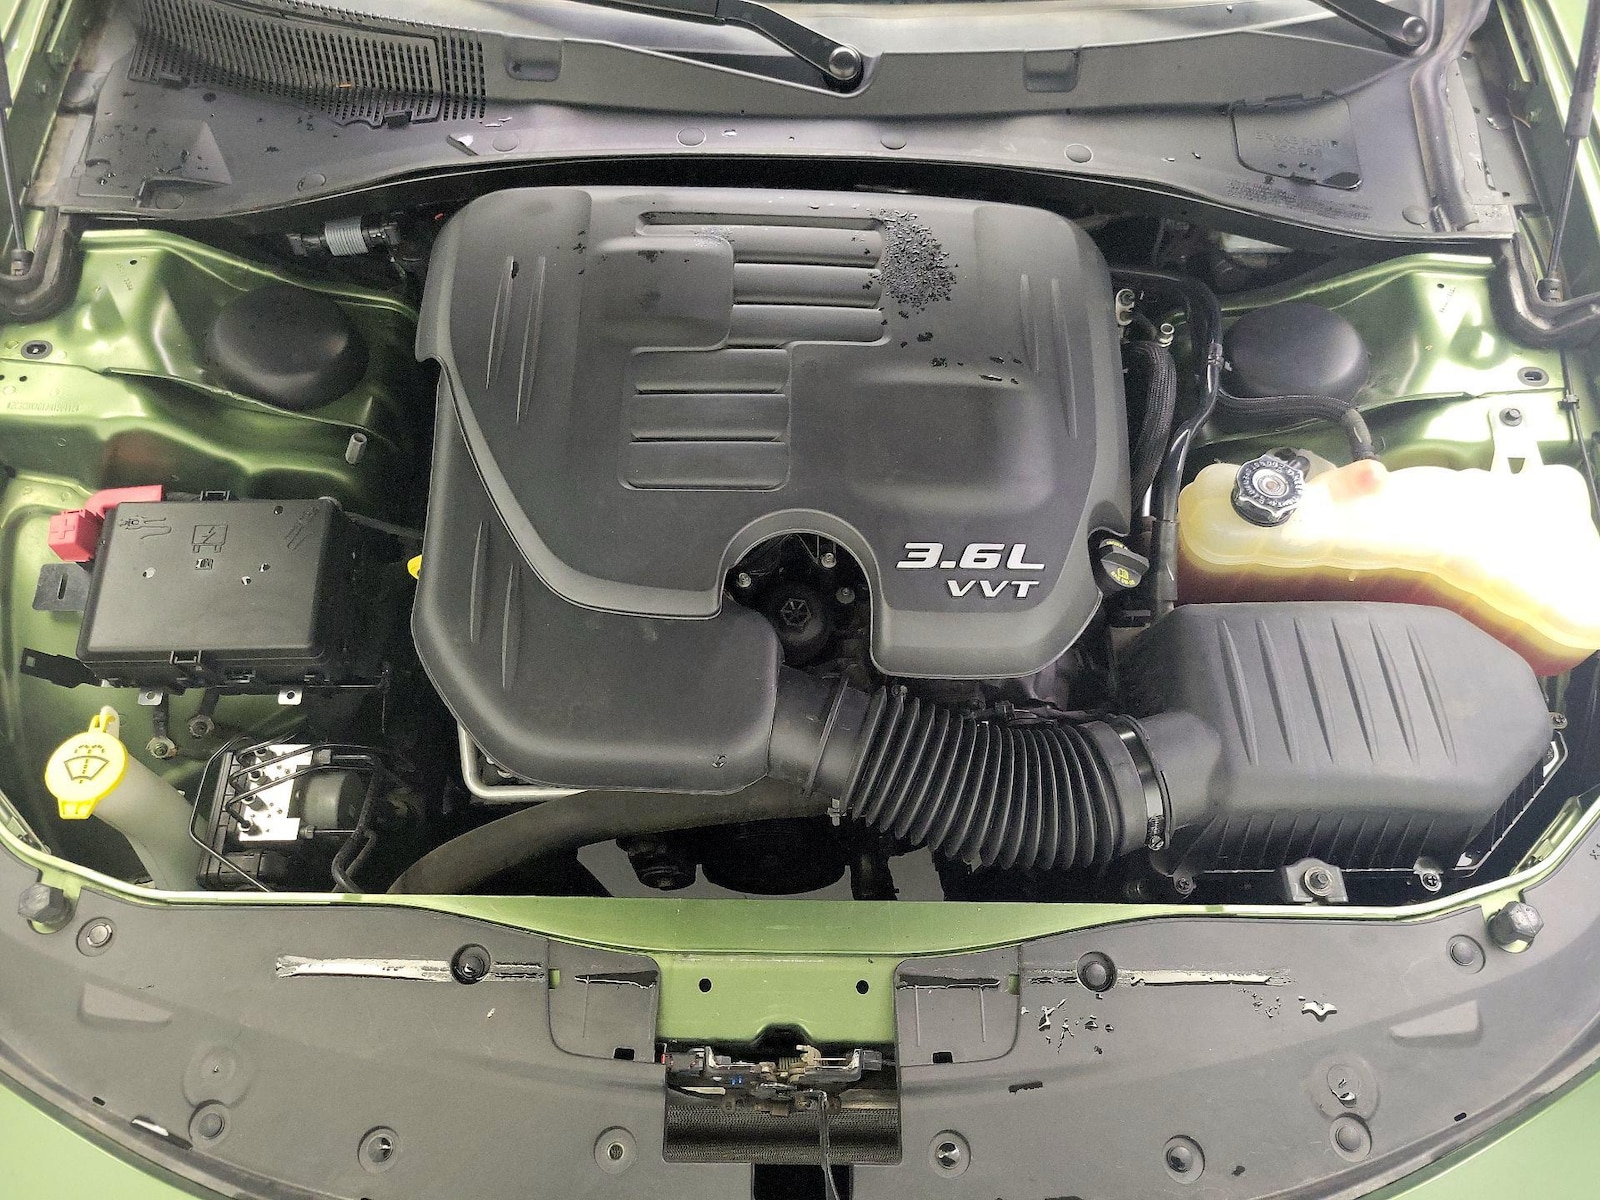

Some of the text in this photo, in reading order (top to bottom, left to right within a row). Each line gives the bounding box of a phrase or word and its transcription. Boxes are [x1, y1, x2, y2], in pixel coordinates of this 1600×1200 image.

[1302, 137, 1339, 149] FLUI
[896, 542, 1046, 570] 3.6L
[946, 580, 1040, 598] VVT
